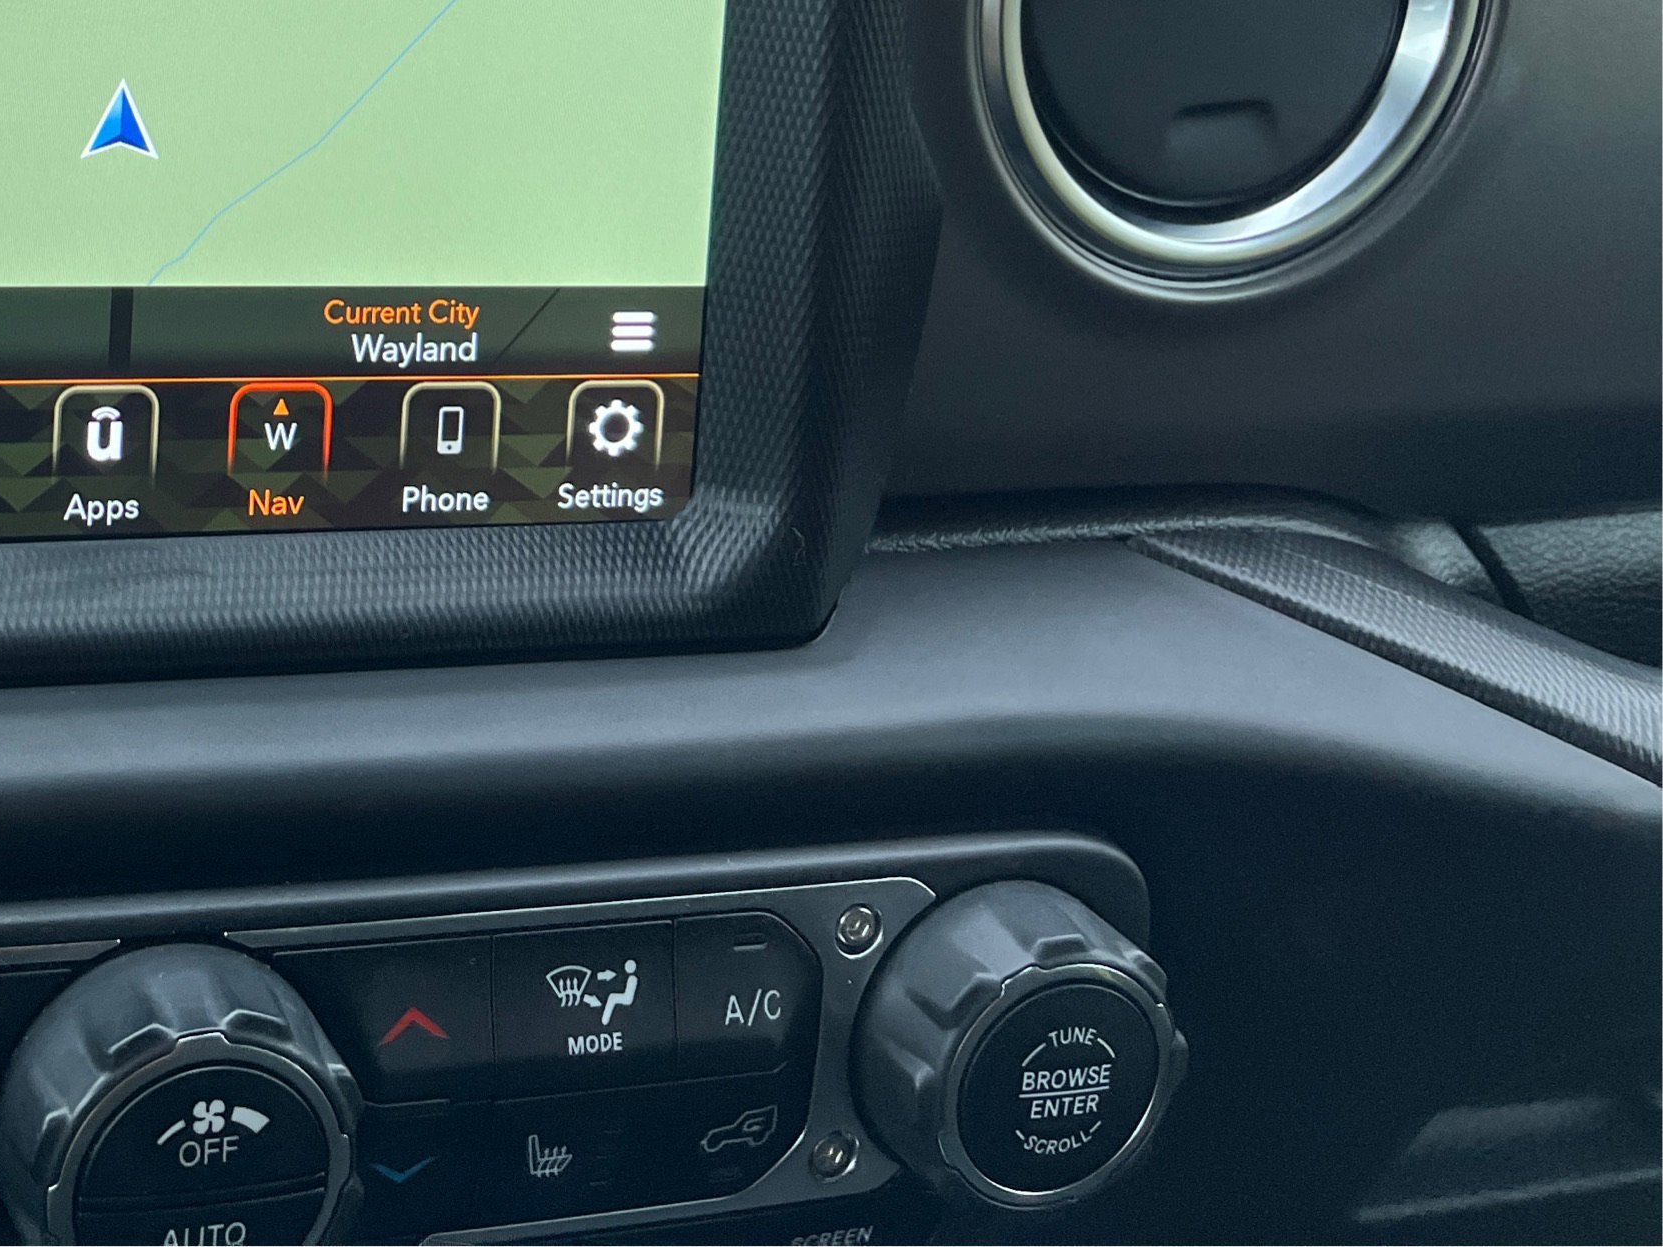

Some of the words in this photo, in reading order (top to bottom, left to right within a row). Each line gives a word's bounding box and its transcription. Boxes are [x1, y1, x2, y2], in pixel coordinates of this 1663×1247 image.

[323, 299, 422, 326] Current
[427, 298, 481, 330] City
[351, 332, 479, 369] Wayland
[263, 422, 298, 453] W
[63, 492, 140, 527] Apps
[248, 490, 306, 517] Nav
[400, 485, 490, 514] Phone
[556, 482, 665, 514] Settings
[724, 988, 782, 1028] A/C
[567, 1031, 623, 1056] MODE
[1047, 1026, 1098, 1049] TUNE
[1021, 1063, 1113, 1092] BROWSE
[1030, 1094, 1100, 1119] ENTER
[178, 1135, 240, 1168] OFF
[1023, 1129, 1092, 1155] SCROLL
[163, 1221, 247, 1246] AUTO
